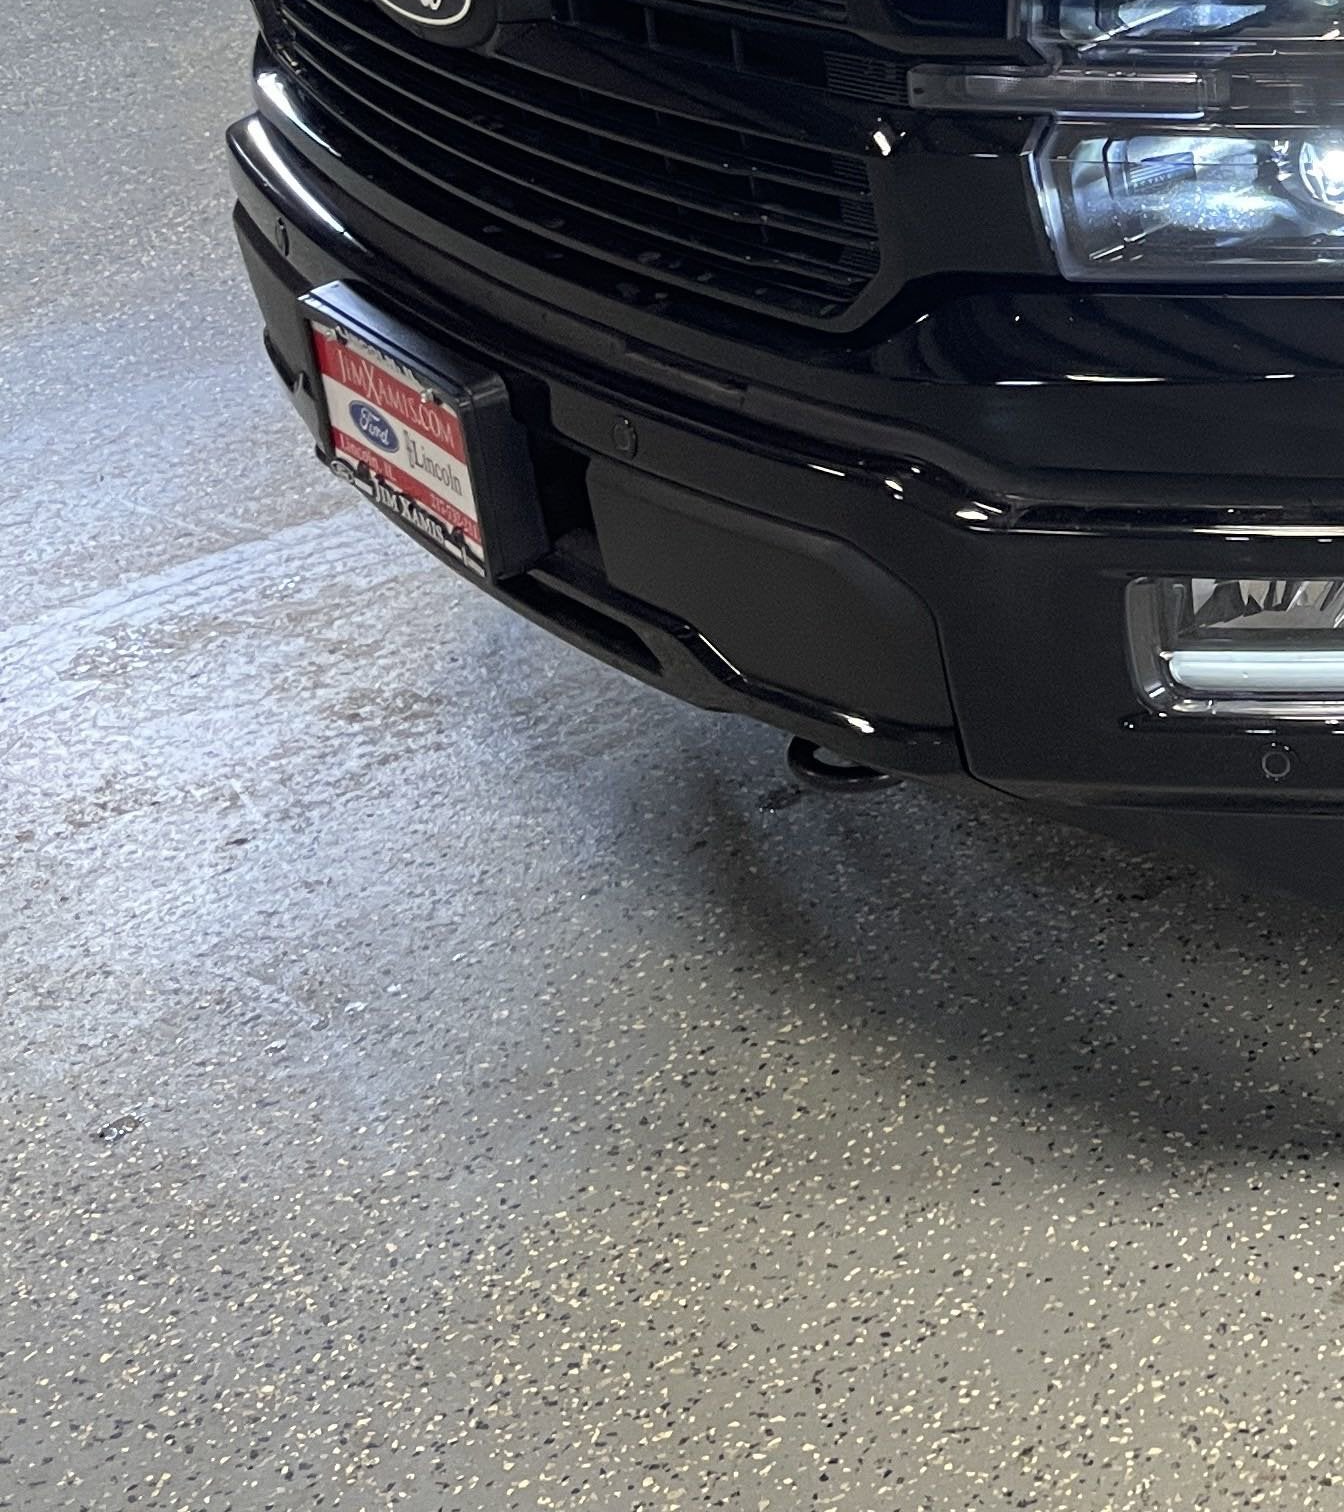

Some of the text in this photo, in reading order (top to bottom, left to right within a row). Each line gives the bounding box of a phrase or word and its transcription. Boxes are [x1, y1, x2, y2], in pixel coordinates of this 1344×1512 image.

[358, 406, 390, 446] Ford
[414, 439, 463, 497] Lincoln
[375, 482, 445, 540] JIM XAMIS
